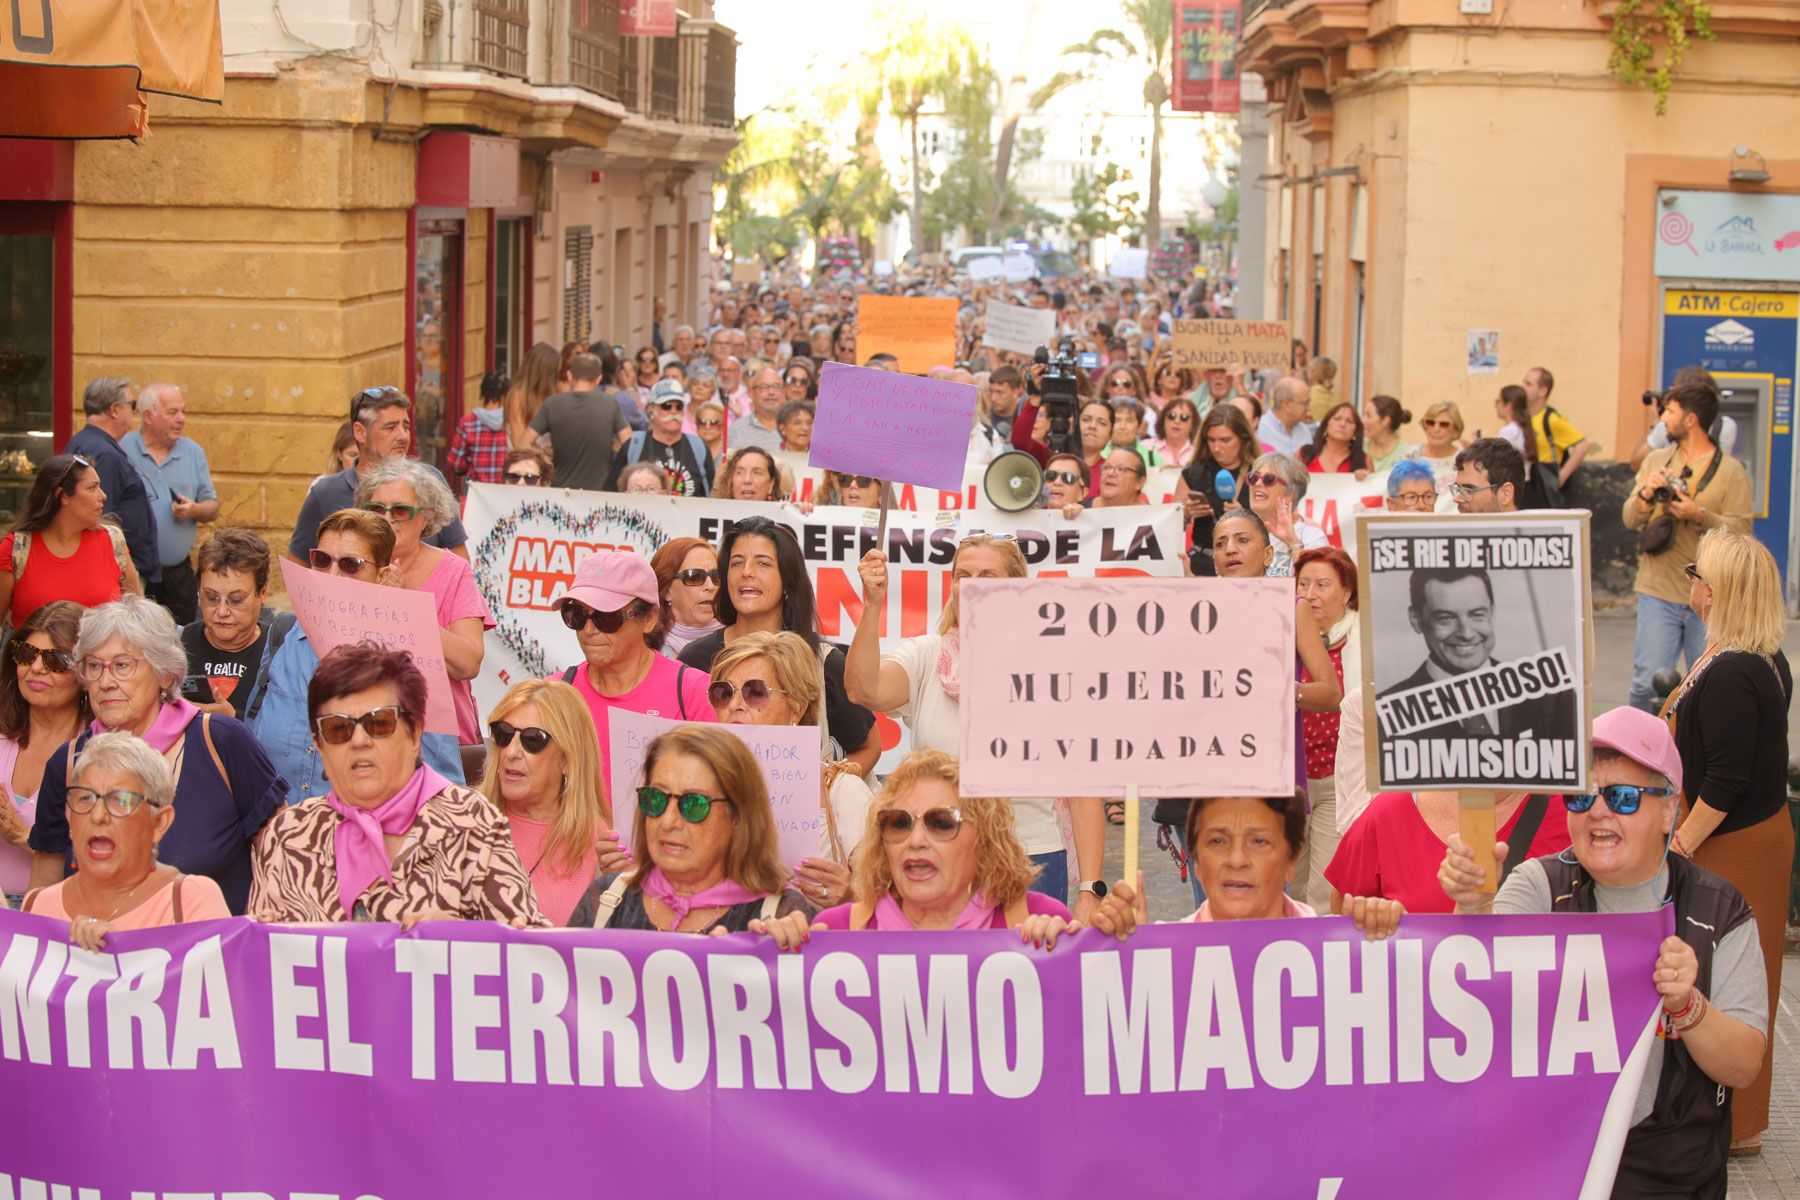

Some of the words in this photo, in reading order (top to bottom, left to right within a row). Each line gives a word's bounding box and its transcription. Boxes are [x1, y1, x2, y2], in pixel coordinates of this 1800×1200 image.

[1679, 295, 1720, 310] ATM
[1729, 295, 1784, 314] Cajero
[1175, 320, 1243, 336] BONILLA
[1247, 323, 1288, 340] MATA
[1217, 337, 1231, 345] LA
[1177, 347, 1239, 364] SANIDAD
[848, 392, 880, 409] POR
[829, 411, 852, 425] LA
[1100, 524, 1165, 562] LA
[1374, 538, 1408, 570] ¡SE
[1413, 537, 1450, 568] RIE
[1454, 536, 1484, 567] DE
[1489, 536, 1571, 567] TODAS!
[1038, 600, 1218, 637] 2000
[1009, 668, 1253, 702] MUJERES
[1381, 652, 1572, 735] ¡MENTIROSO!
[990, 733, 1257, 762] OLVIDADAS
[1382, 728, 1576, 781] ¡DIMISIÓN!
[771, 769, 808, 781] BIEN
[269, 932, 373, 1077] EL
[395, 938, 1043, 1098] TERRORISMO
[1081, 934, 1621, 1094] MACHISTA
